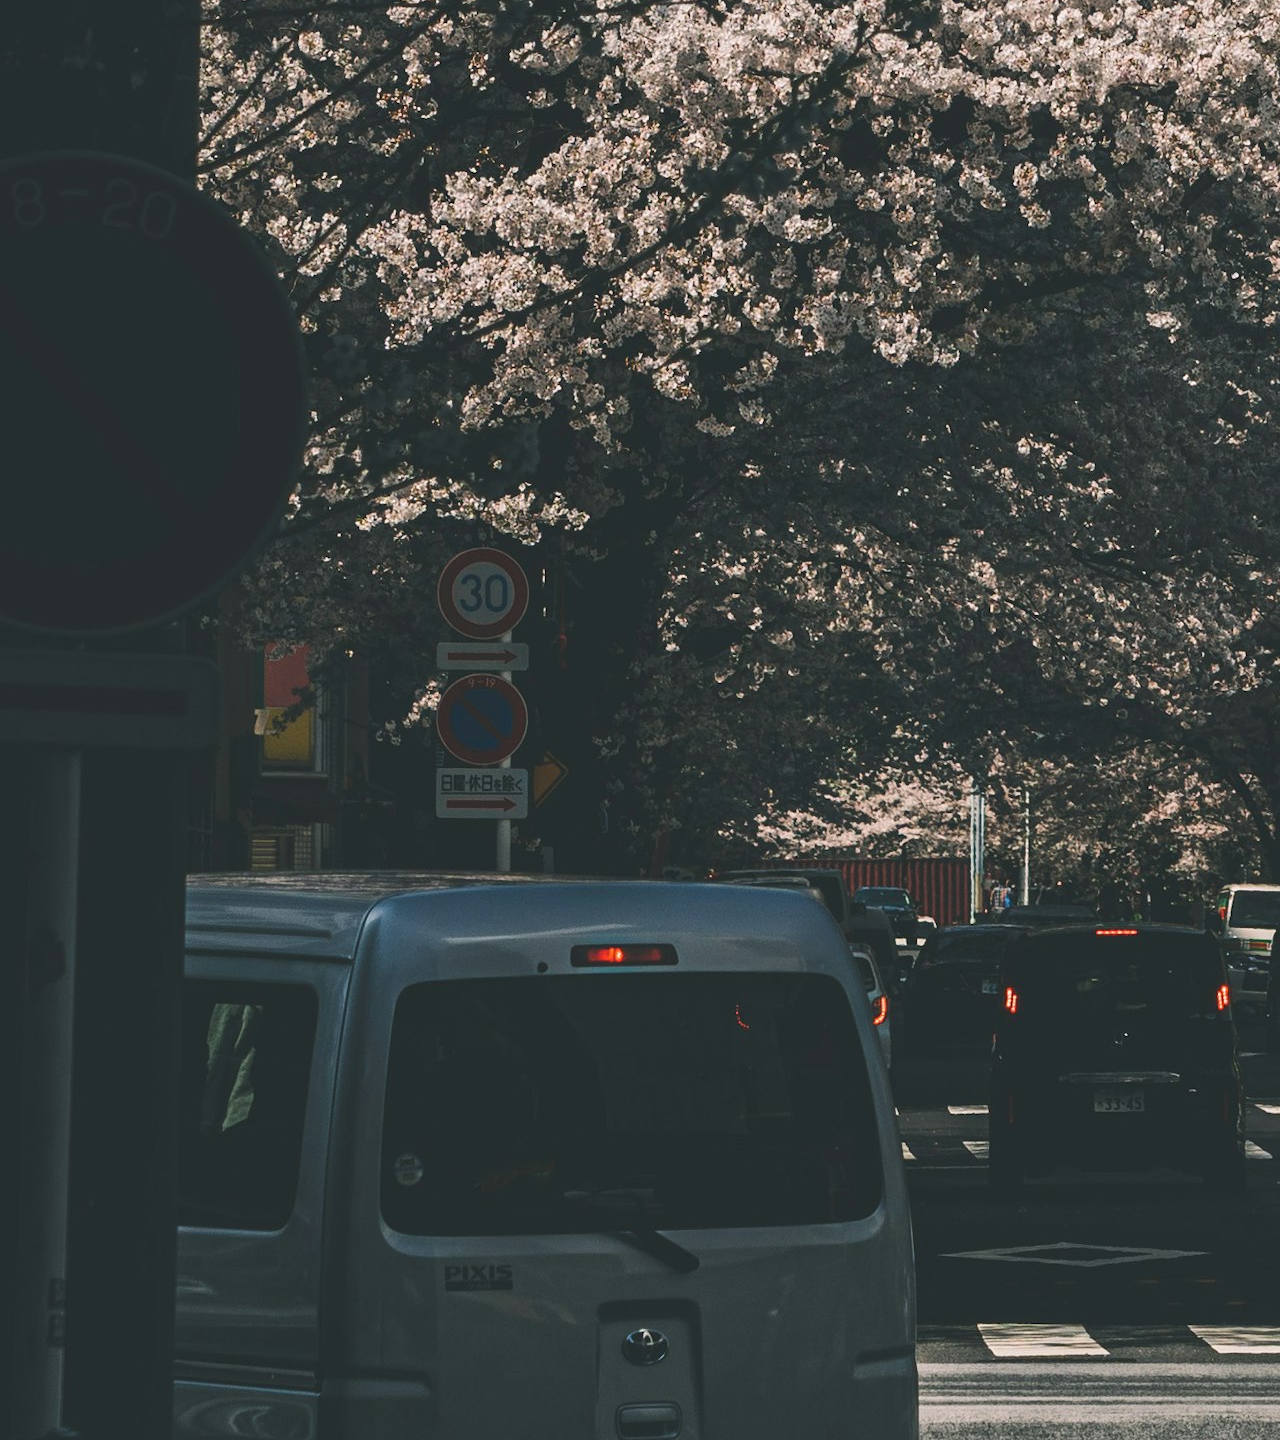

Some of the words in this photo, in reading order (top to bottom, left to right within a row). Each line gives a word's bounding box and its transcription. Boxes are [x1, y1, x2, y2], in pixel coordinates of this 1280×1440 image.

[460, 573, 508, 613] 30
[467, 677, 497, 690] 9-19
[445, 1265, 513, 1281] PIXIS
